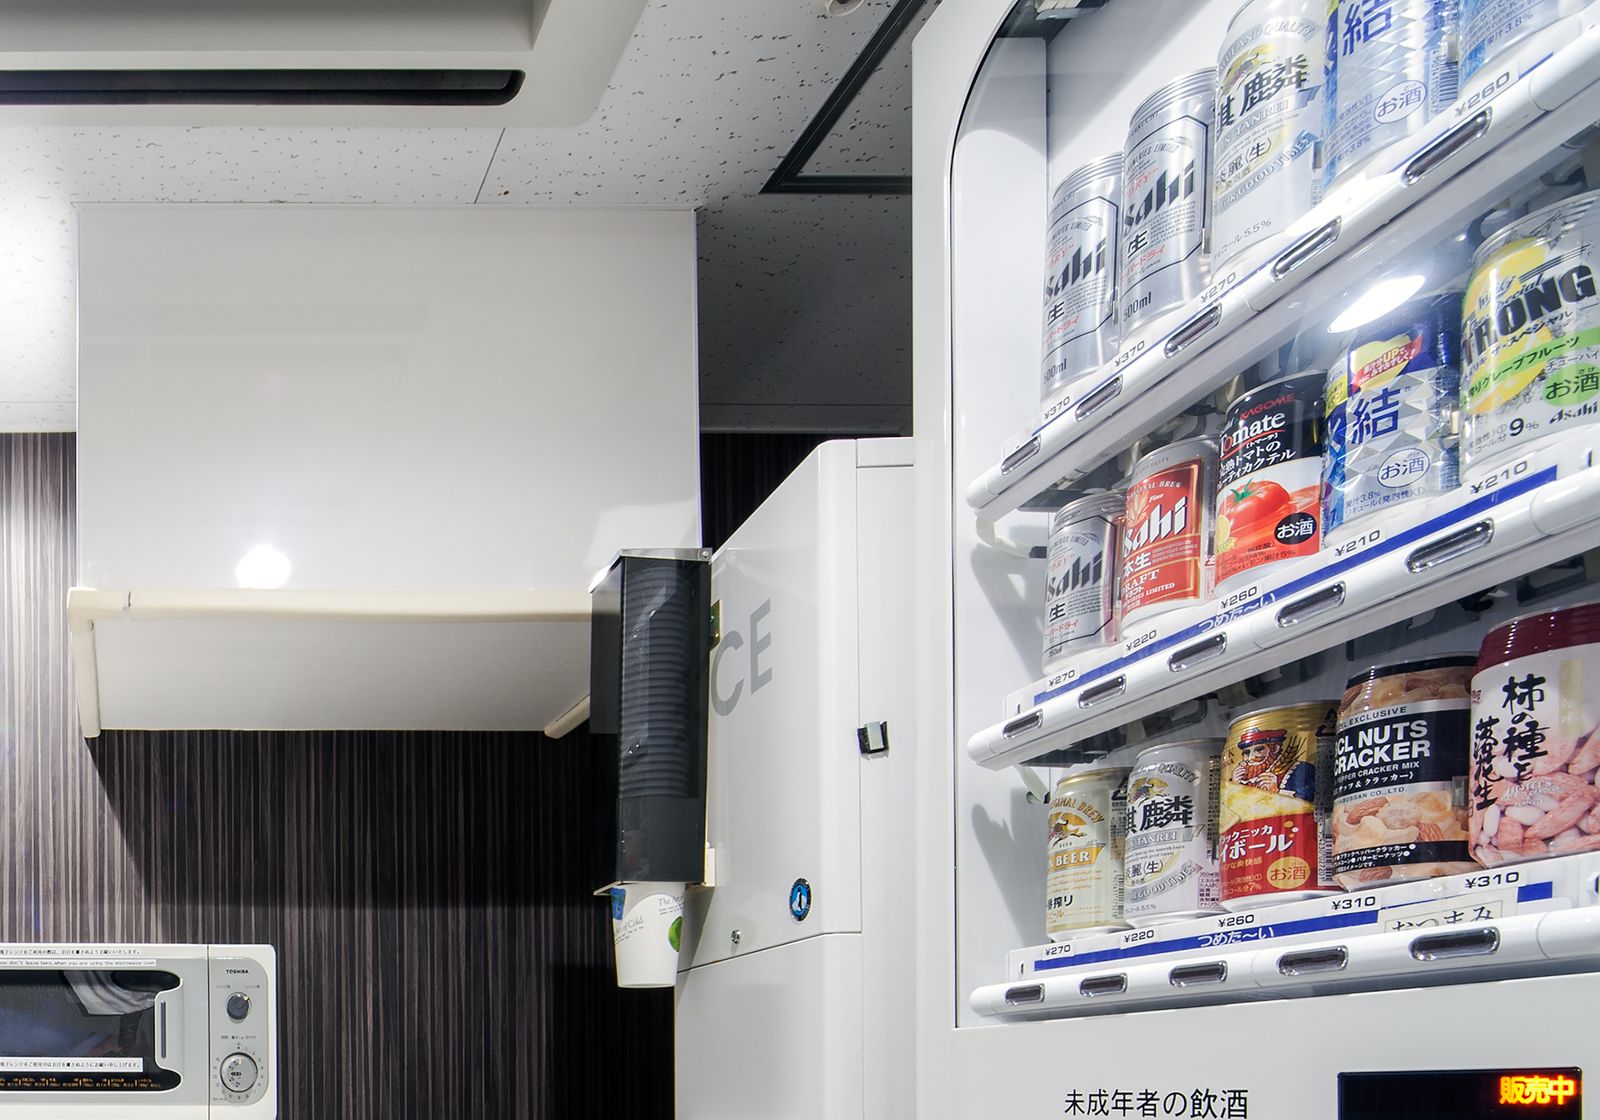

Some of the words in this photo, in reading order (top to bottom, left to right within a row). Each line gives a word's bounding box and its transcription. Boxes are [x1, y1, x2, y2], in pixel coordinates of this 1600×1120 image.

[1377, 86, 1422, 118] お酒
[1454, 70, 1512, 117] ¥260
[1200, 271, 1238, 305] ¥270
[1114, 339, 1146, 368] ¥370
[1544, 373, 1600, 401] お酒
[1043, 395, 1071, 420] ¥370
[1239, 393, 1294, 421] KAGOME
[1549, 401, 1599, 425] Asahi
[1380, 456, 1426, 480] お酒
[1469, 460, 1529, 495] ¥210
[1276, 519, 1315, 539] お酒
[1334, 528, 1381, 558] ¥210
[1125, 629, 1158, 652] ¥220
[1048, 668, 1077, 688] ¥270
[1348, 705, 1408, 727] EXCLUSIVE
[1357, 720, 1429, 748] NUTS
[1502, 673, 1550, 784] 柿の種と
[1157, 762, 1200, 784] QUALITY
[1357, 762, 1399, 778] CRACKER
[1401, 760, 1420, 772] MIX
[1472, 714, 1501, 811] 落花生
[1270, 863, 1308, 883] お酒
[1464, 871, 1520, 889] ¥310
[1331, 895, 1377, 911] ¥310
[1218, 913, 1256, 929] ¥260
[1124, 929, 1155, 943] ¥220
[1045, 944, 1072, 956] ¥270
[1498, 1074, 1576, 1107] 販売中
[1063, 1087, 1250, 1120] 未成年者の飲酒
